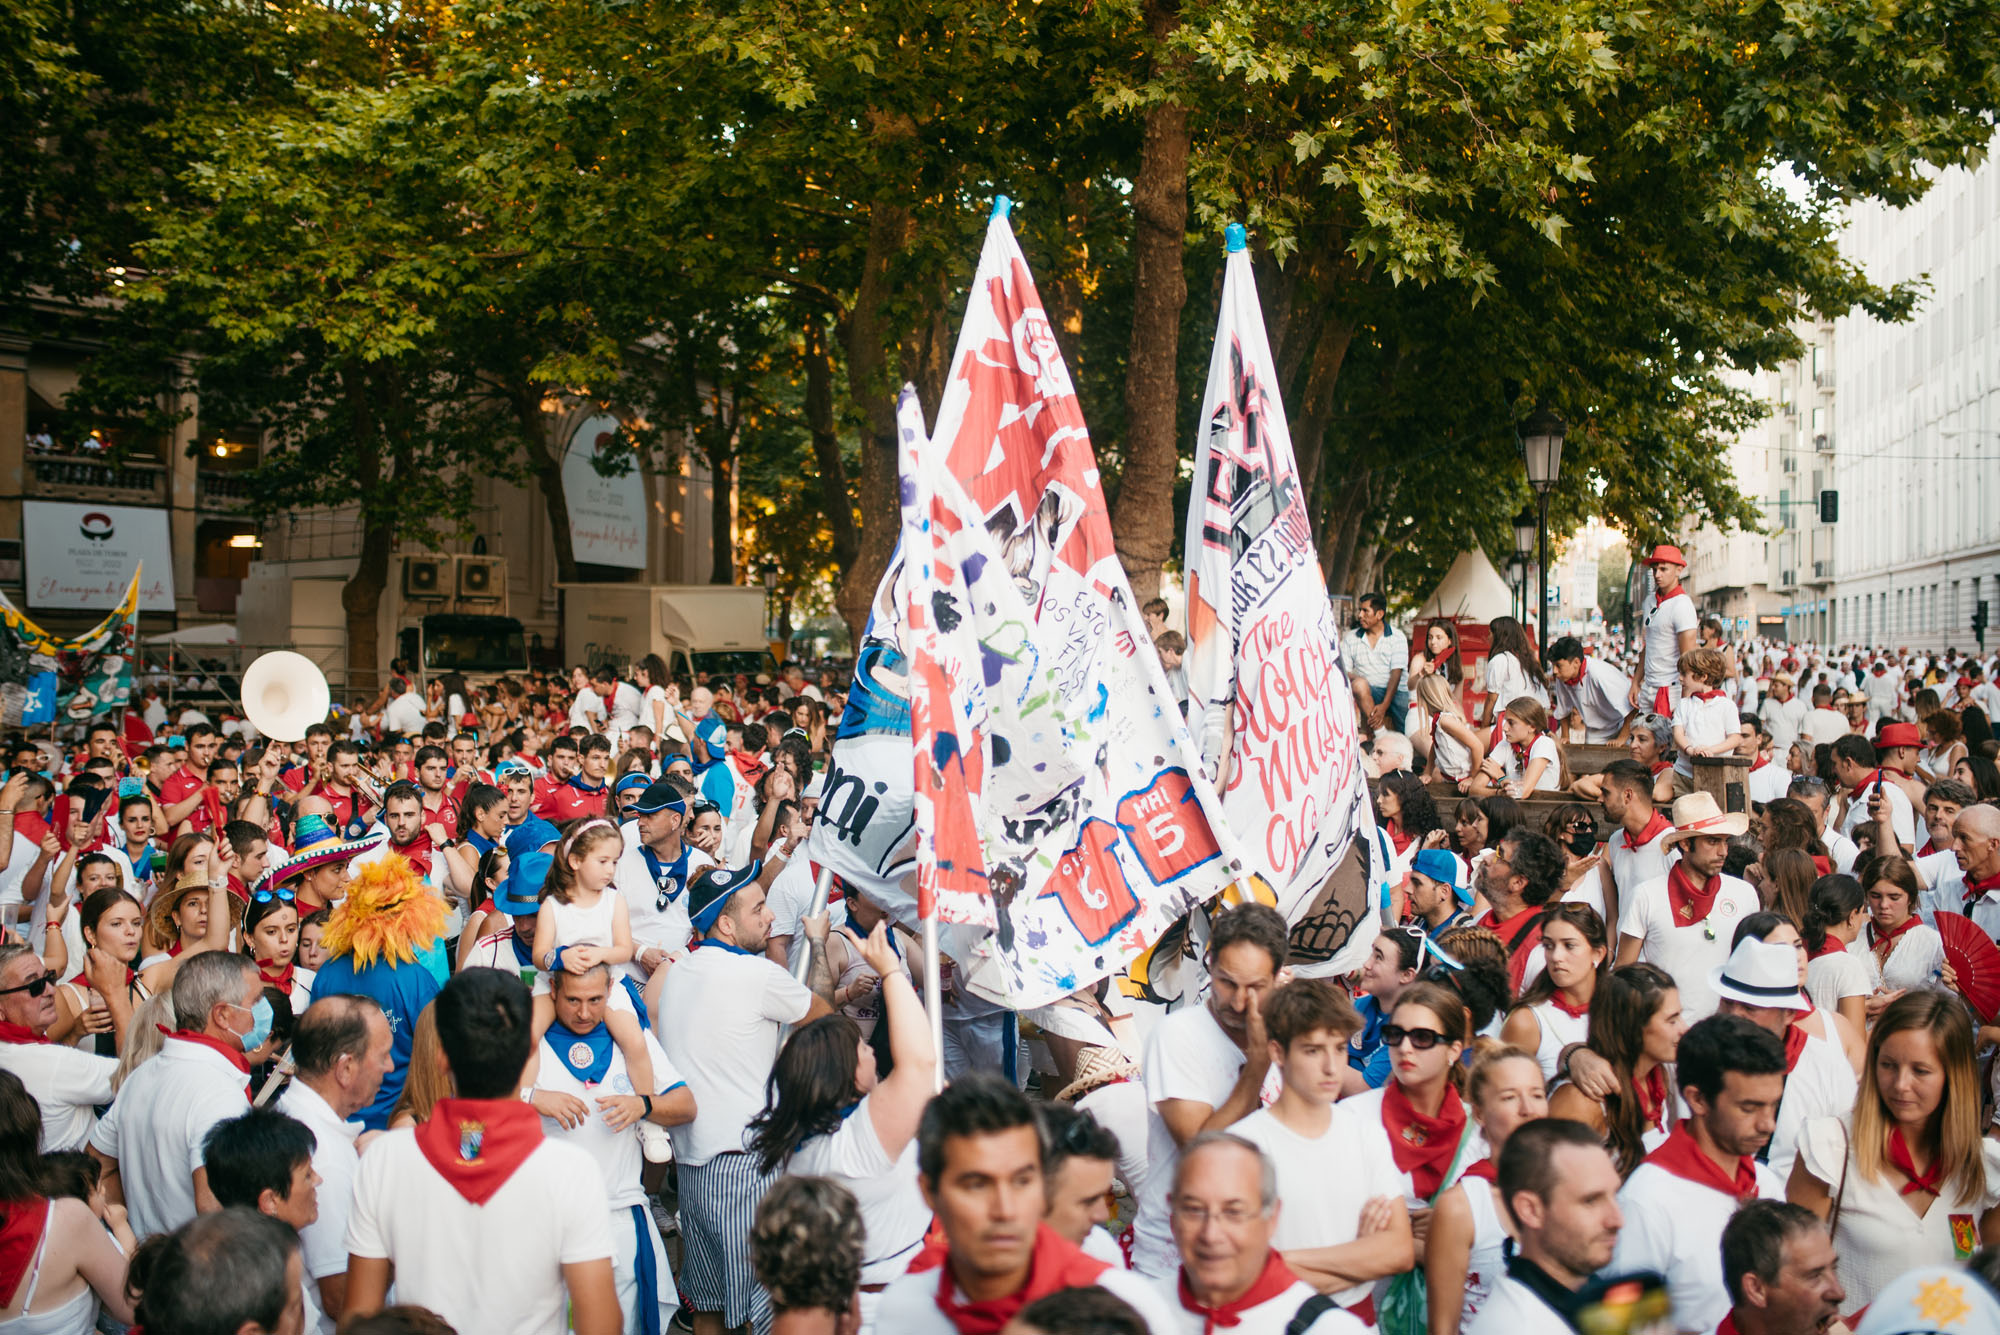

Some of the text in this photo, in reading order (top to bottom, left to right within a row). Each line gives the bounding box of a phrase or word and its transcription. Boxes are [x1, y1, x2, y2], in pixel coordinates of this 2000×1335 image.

[1242, 611, 1294, 664] The
[1133, 786, 1171, 819] MAI
[1146, 812, 1185, 858] 5
[1079, 864, 1109, 911] 6
